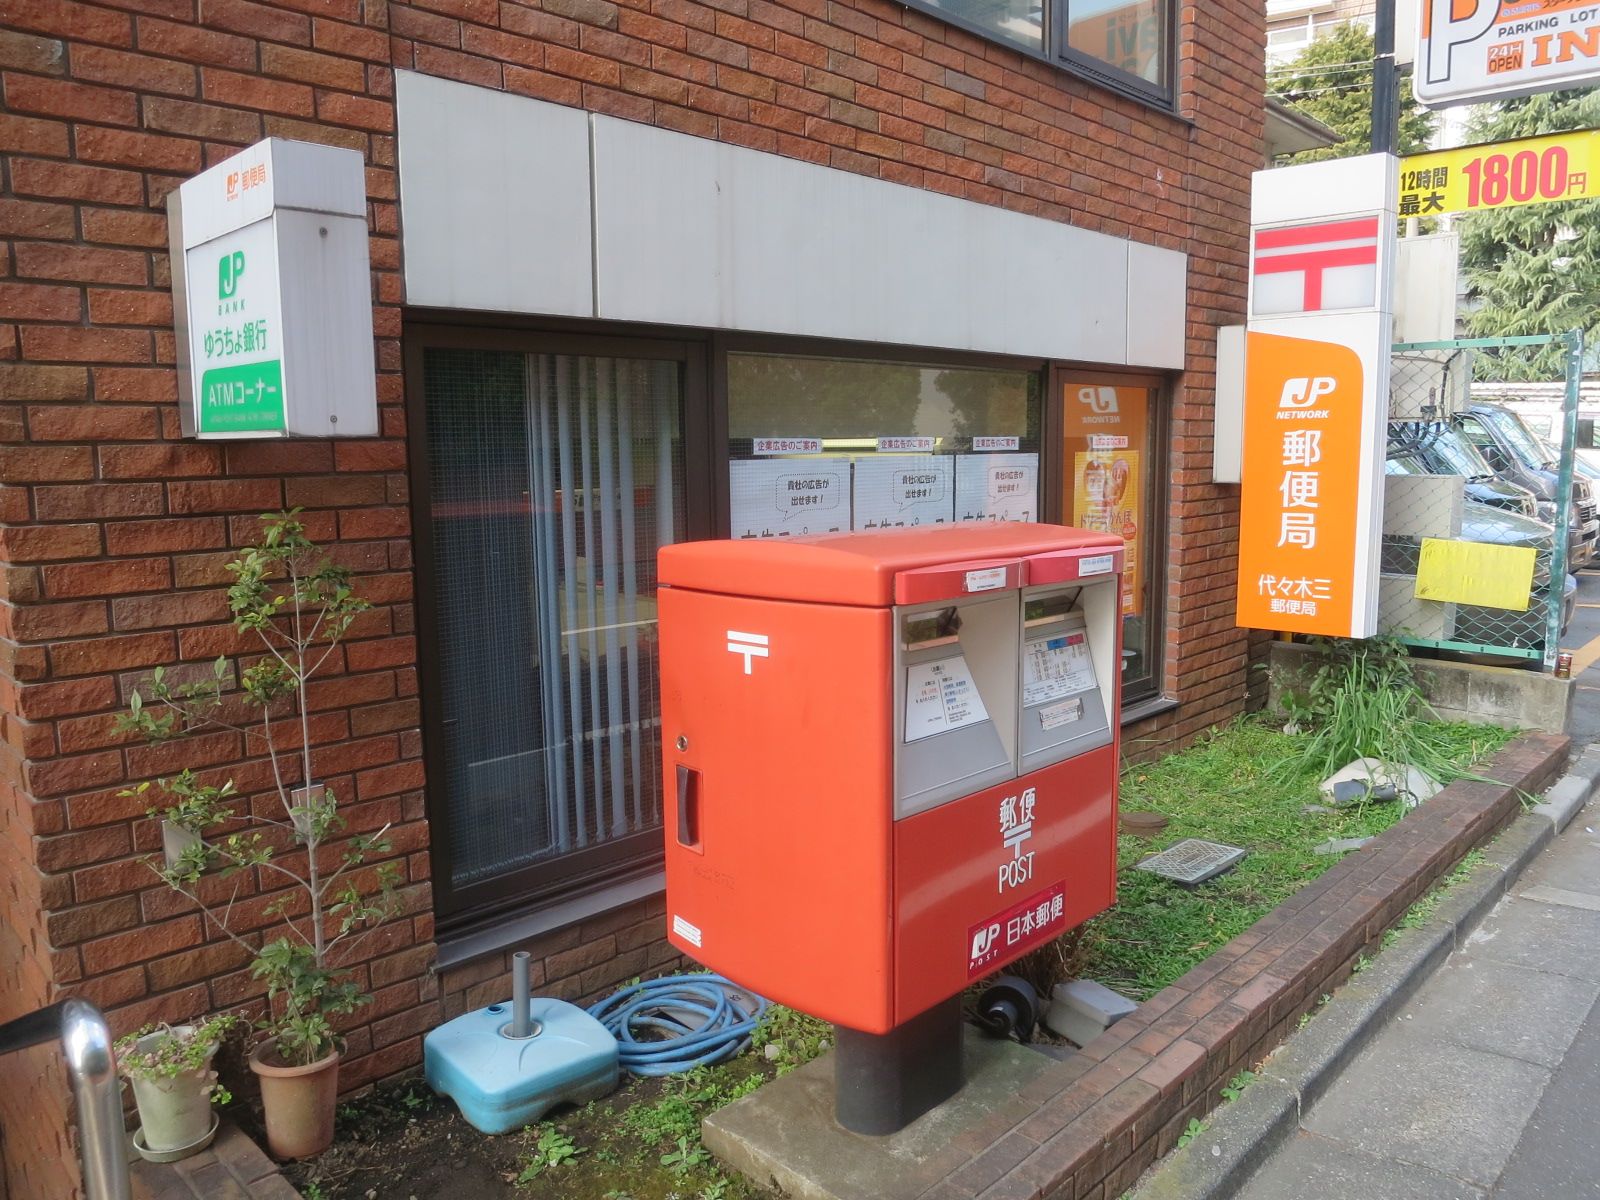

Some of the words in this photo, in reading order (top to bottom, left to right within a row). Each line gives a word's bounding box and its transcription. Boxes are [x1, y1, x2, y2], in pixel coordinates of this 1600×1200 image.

[1498, 17, 1559, 38] PARKING
[1570, 9, 1598, 24] LOT
[1488, 44, 1523, 60] 24H
[1488, 54, 1523, 74] OPEN
[241, 164, 266, 191] 郵便局
[1400, 166, 1448, 192] 12時間
[1462, 146, 1587, 208] 1800円
[1399, 191, 1445, 216] 最大
[219, 251, 245, 300] JP
[218, 299, 246, 316] BANK
[204, 319, 268, 359] ゆうちょ銀行
[209, 377, 277, 408] ATMコーナー
[1279, 376, 1337, 408] JP
[1276, 409, 1330, 420] NETWORK
[757, 440, 818, 452] 企業広告のご案内
[787, 478, 830, 491] 貴社の広告が
[1276, 429, 1322, 549] 郵便局
[1258, 574, 1332, 600] 代々木三
[1270, 598, 1317, 617] 郵便局
[999, 787, 1036, 833] 郵便
[998, 851, 1035, 894] POST
[971, 923, 1001, 960] JP
[1007, 893, 1064, 946] 日本郵便
[969, 949, 998, 970] POST
